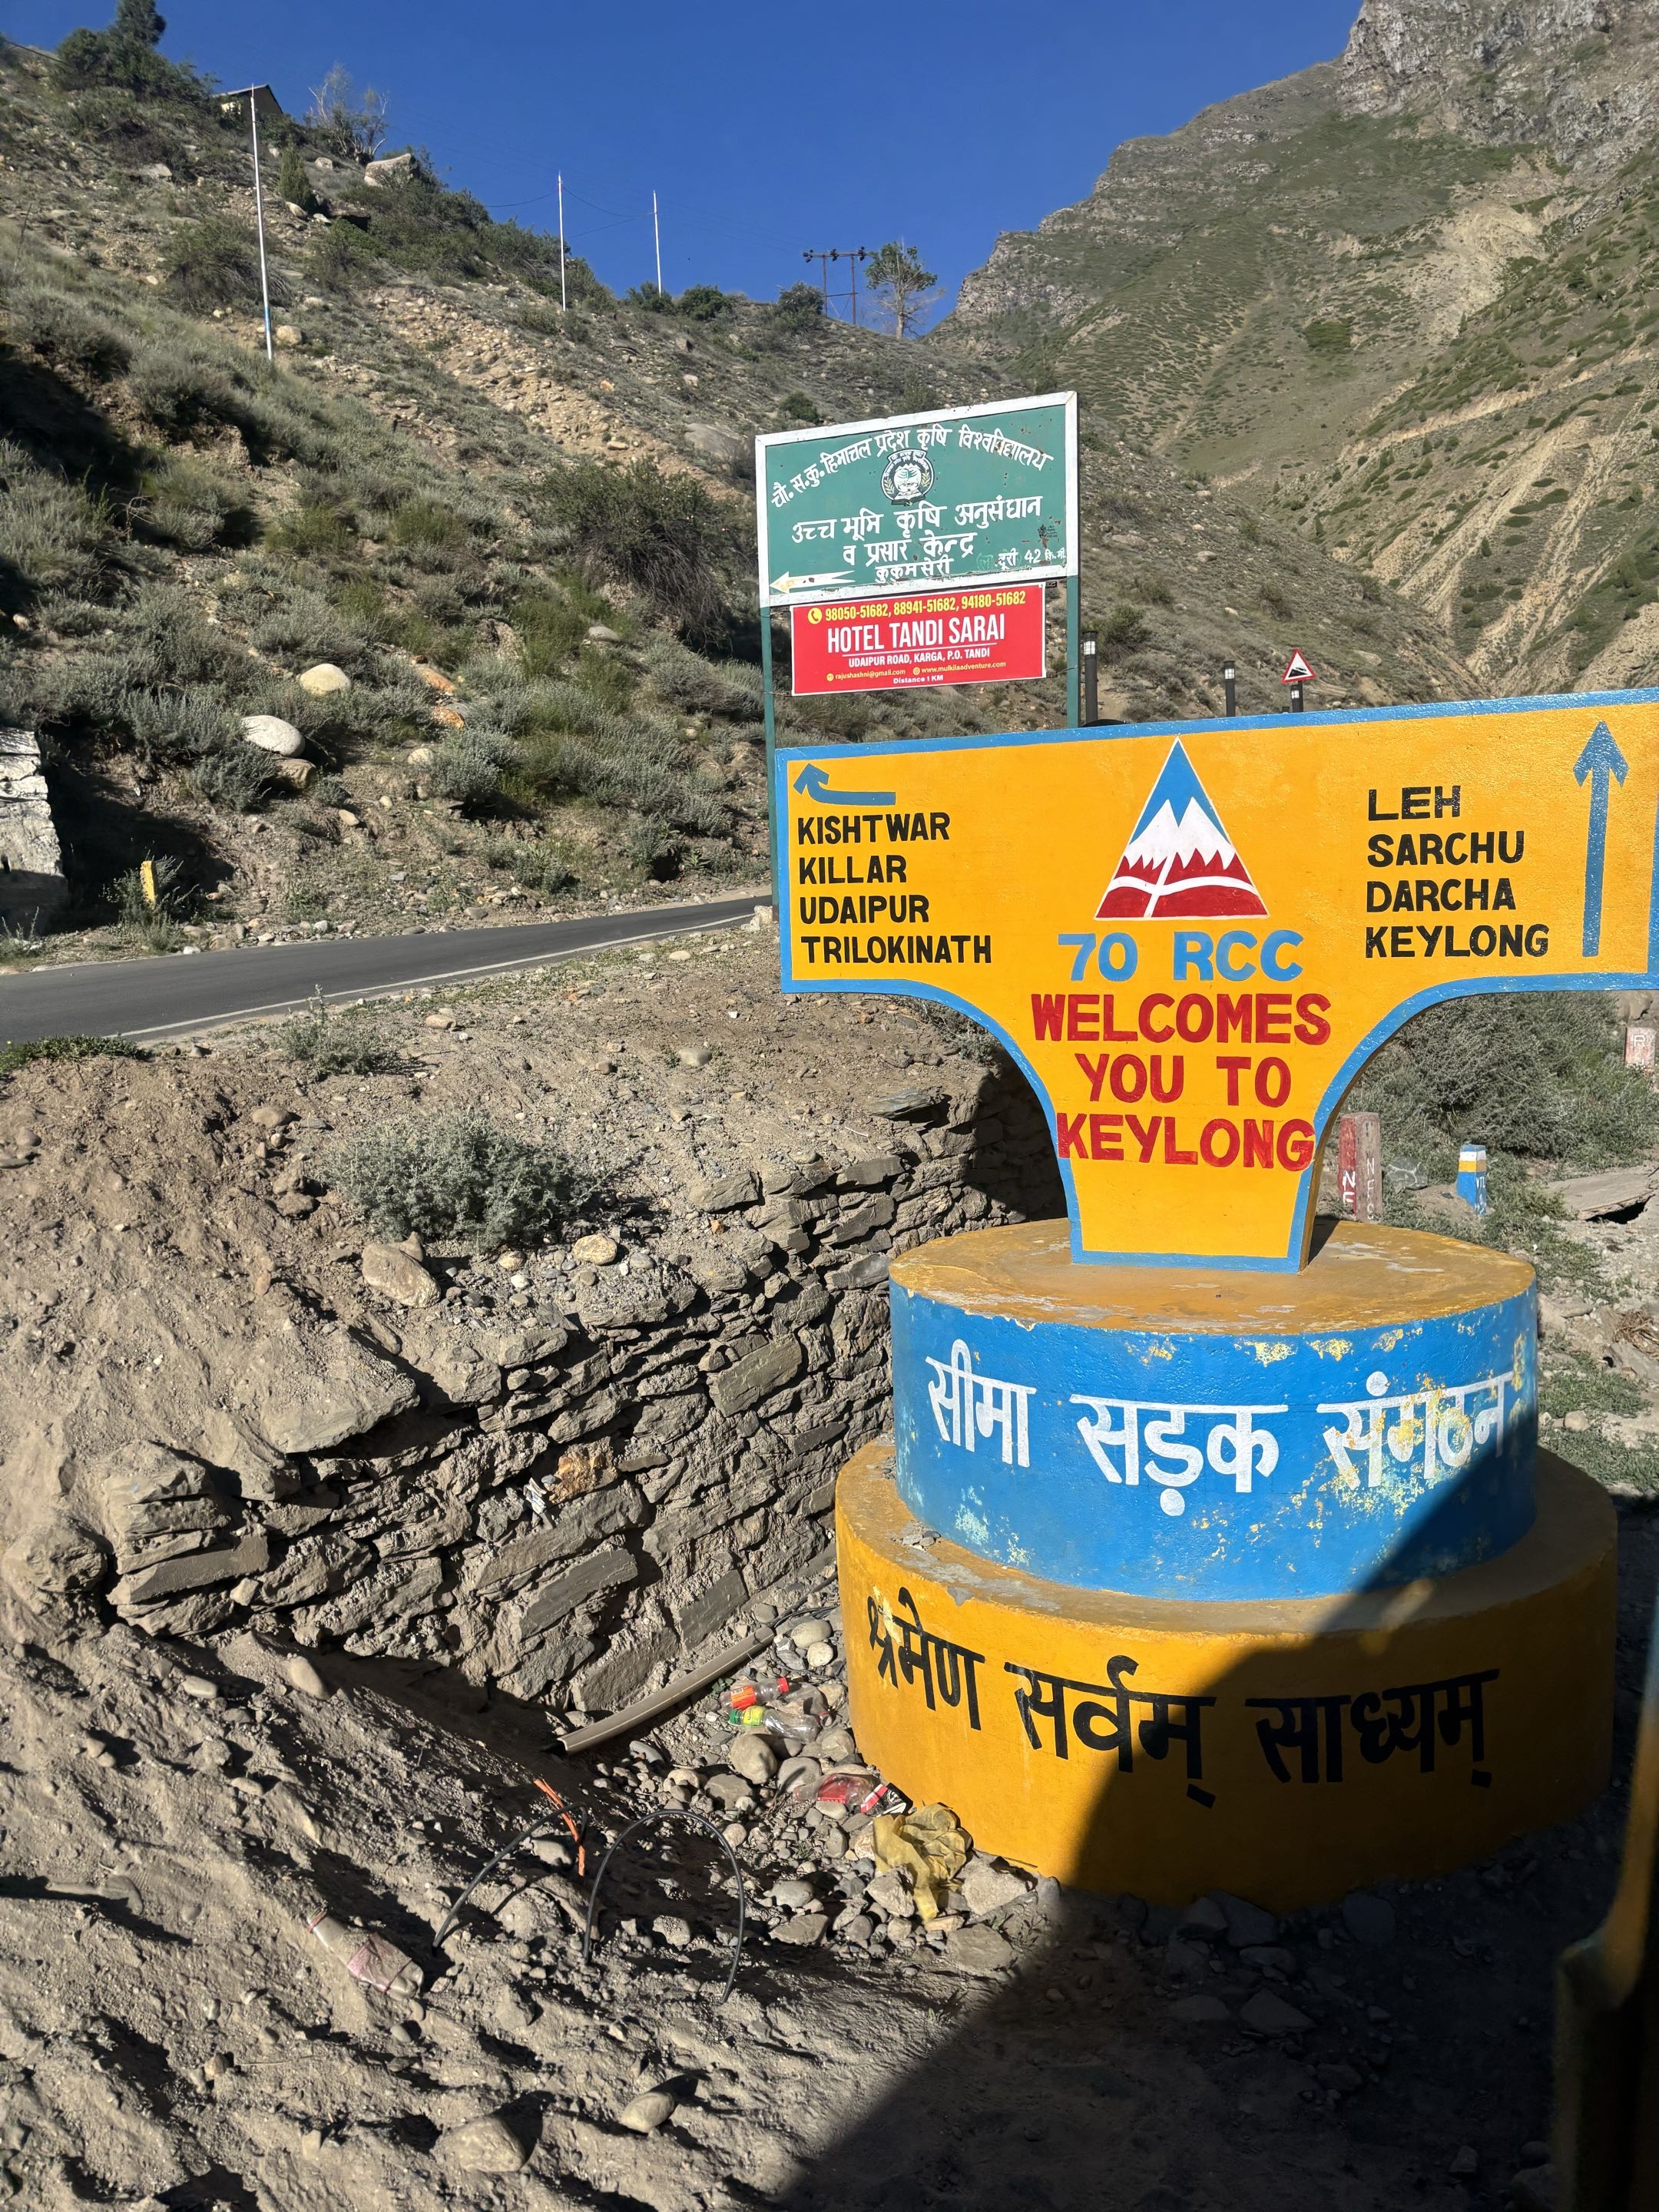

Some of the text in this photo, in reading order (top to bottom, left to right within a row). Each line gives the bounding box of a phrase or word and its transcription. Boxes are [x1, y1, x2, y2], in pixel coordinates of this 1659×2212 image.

[874, 429, 911, 458] प्रदेश
[916, 423, 953, 451] कृषि
[792, 518, 837, 544] उच्च
[840, 507, 885, 541] भूमि
[893, 500, 948, 539] कृषि
[843, 529, 979, 568] व प्रसार केन्द्र
[1024, 548, 1041, 564] 42
[825, 591, 1026, 621] 98050-51682, 88941-51682, 94180-51682
[827, 614, 1005, 654] HOTEL TANDI SARAI
[849, 646, 990, 668] UDAIPUR ROAD, KARGA, P.O. TANDI
[892, 676, 926, 685] Distance
[1367, 784, 1462, 821] LEH
[797, 812, 951, 845] KISHTWAR
[1366, 830, 1525, 868] SARCHU
[799, 854, 908, 885] KILLAR
[800, 894, 930, 925] UDAIPUR
[1366, 877, 1516, 913] DARCHA
[800, 935, 992, 964] TRILOKINATH
[1057, 929, 1304, 982] 70 RCC
[1365, 923, 1551, 959] KEYLONG
[1031, 992, 1332, 1046] WELCOMES
[1075, 1052, 1292, 1108] YOU TO
[1056, 1112, 1316, 1172] KEYLONG
[925, 1338, 1515, 1517] सीमा सड़क संगठन
[866, 1586, 1502, 1810] श्रमेण सर्वम् साध्यम्
